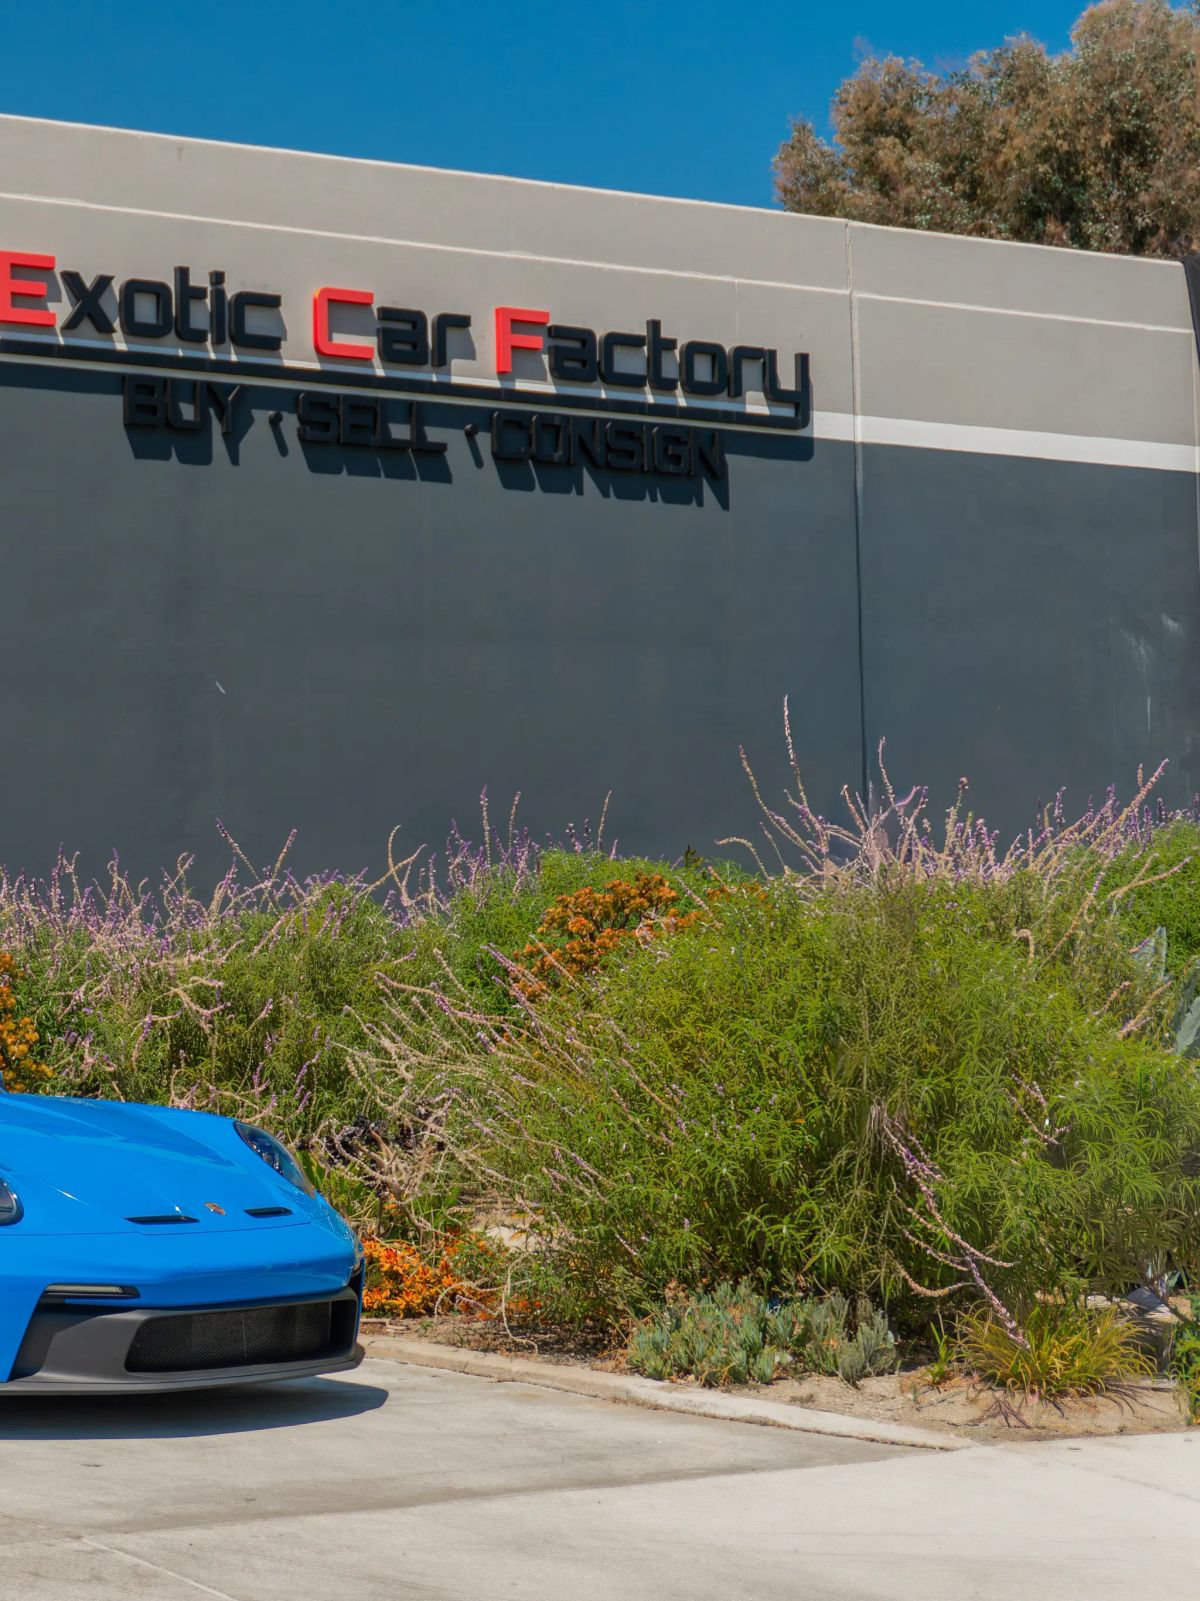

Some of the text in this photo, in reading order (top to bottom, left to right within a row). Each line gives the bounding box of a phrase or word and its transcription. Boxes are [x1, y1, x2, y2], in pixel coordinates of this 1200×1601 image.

[313, 286, 472, 368] Car
[495, 306, 811, 430] Factory
[123, 373, 725, 479] BUY SELL CONSIGN
